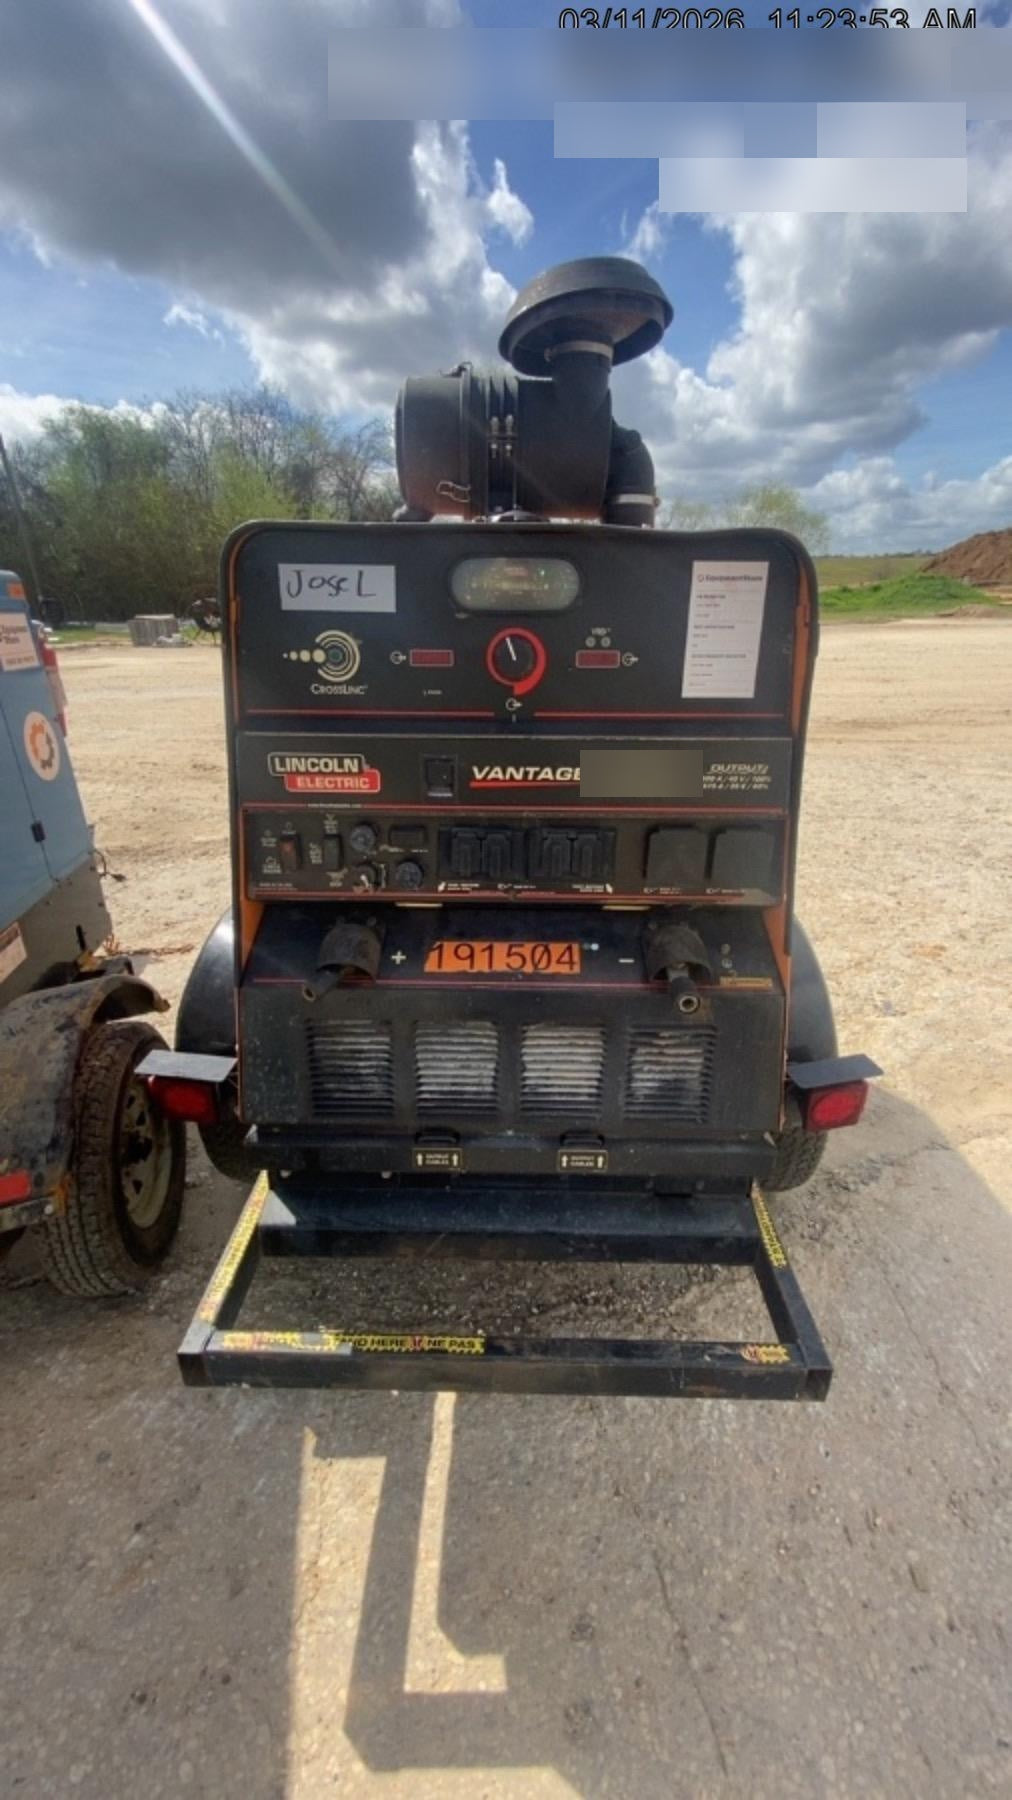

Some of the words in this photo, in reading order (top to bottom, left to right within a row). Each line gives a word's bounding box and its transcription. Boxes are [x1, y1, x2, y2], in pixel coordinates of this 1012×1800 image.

[274, 757, 360, 773] LINCOLN
[296, 776, 370, 789] ELECTRIC
[430, 943, 576, 971] 191504
